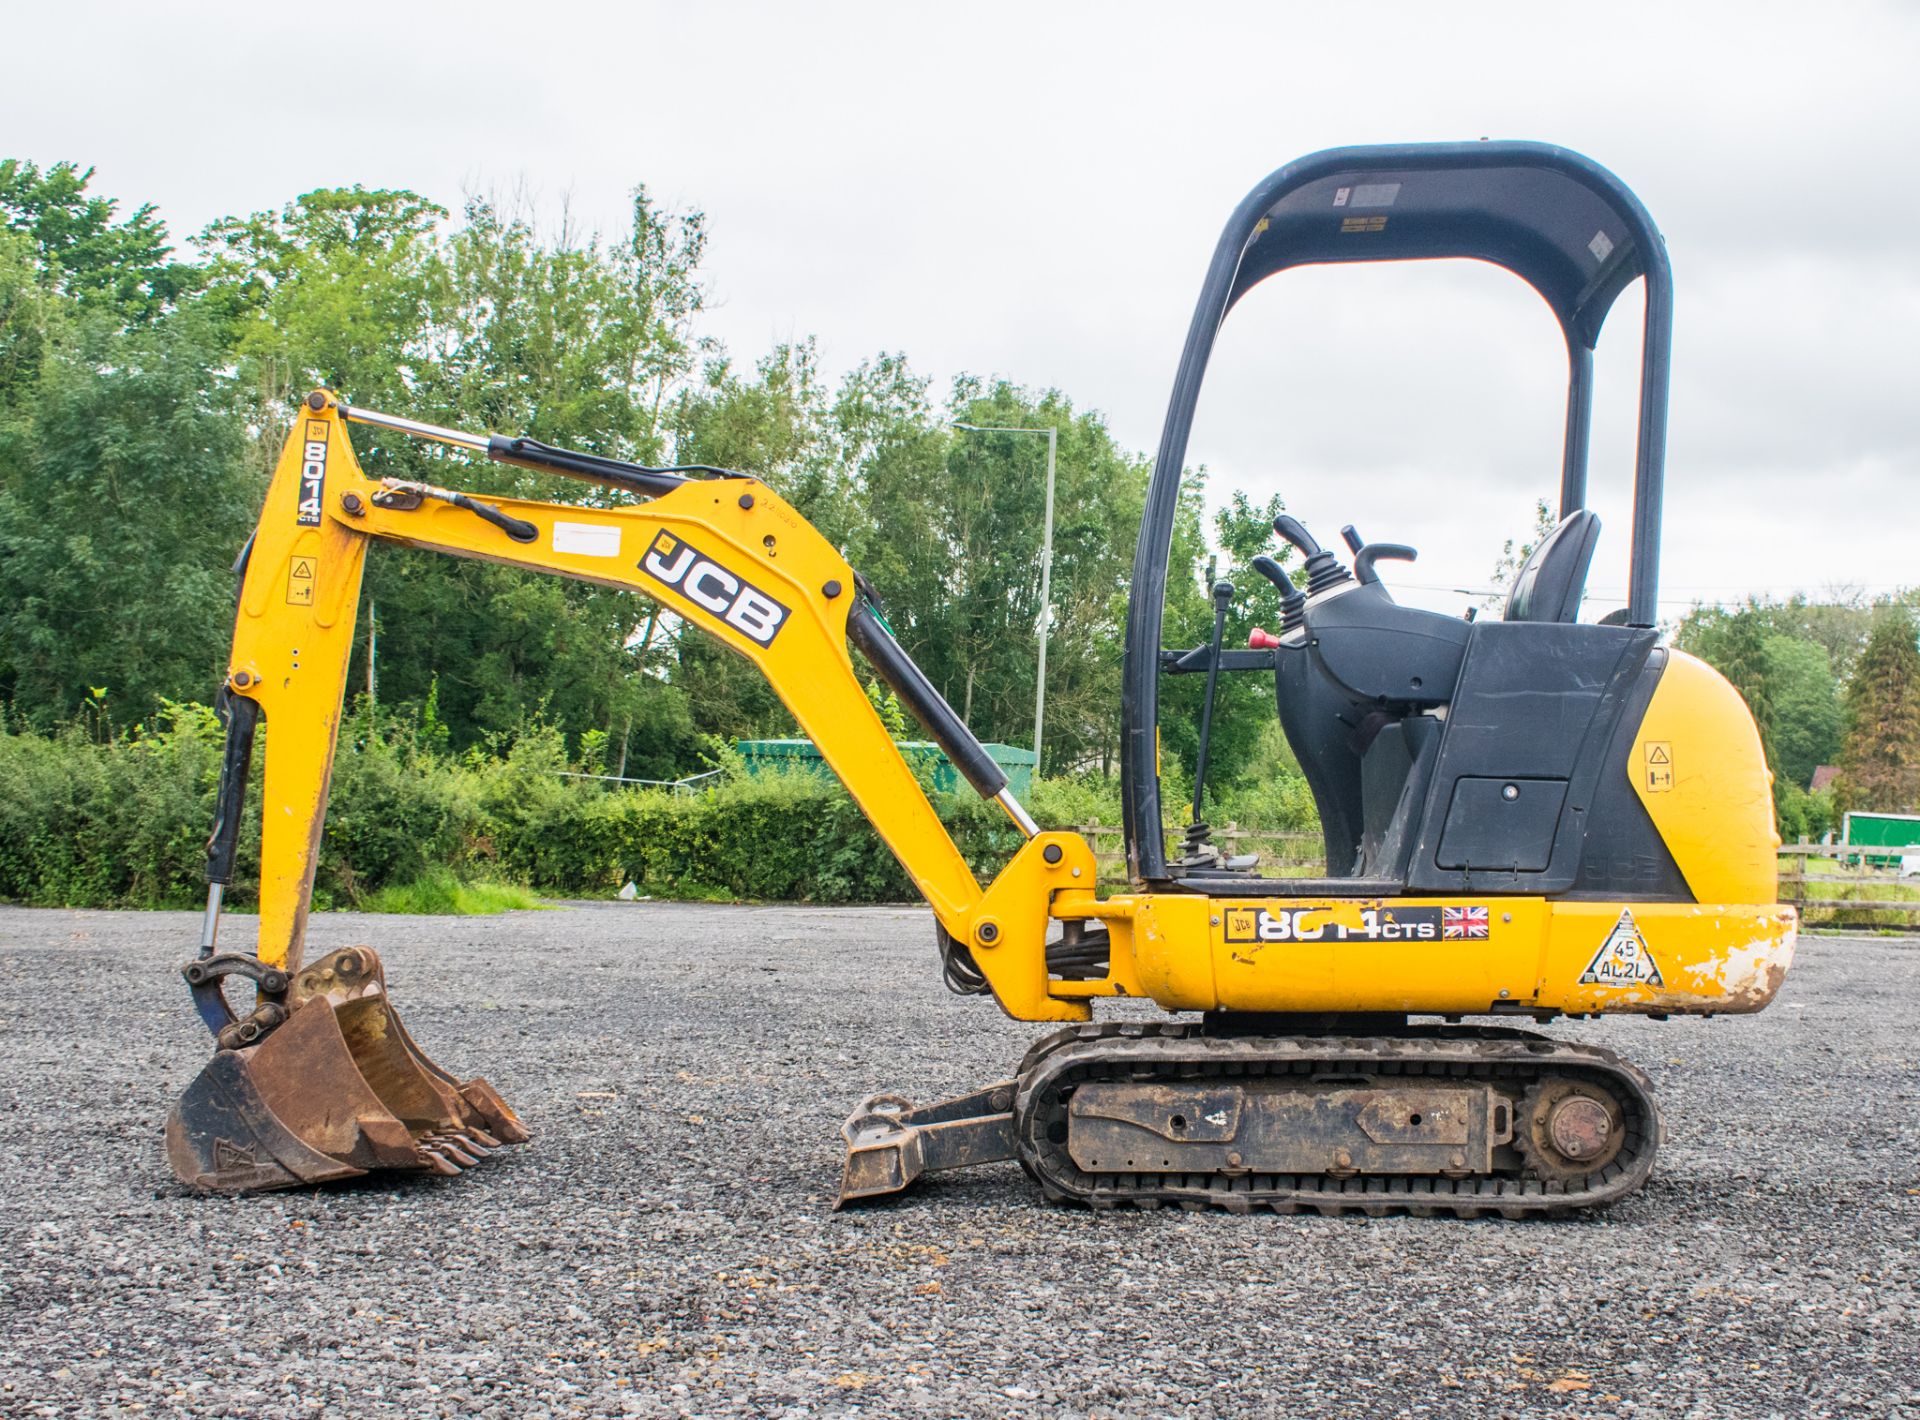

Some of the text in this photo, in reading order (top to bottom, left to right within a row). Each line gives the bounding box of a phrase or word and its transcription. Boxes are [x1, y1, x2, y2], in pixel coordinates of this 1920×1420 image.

[299, 441, 327, 516] 8014
[298, 515, 320, 523] CTS
[645, 547, 783, 642] JCB
[1234, 918, 1251, 932] JCB
[1615, 940, 1635, 957] 45
